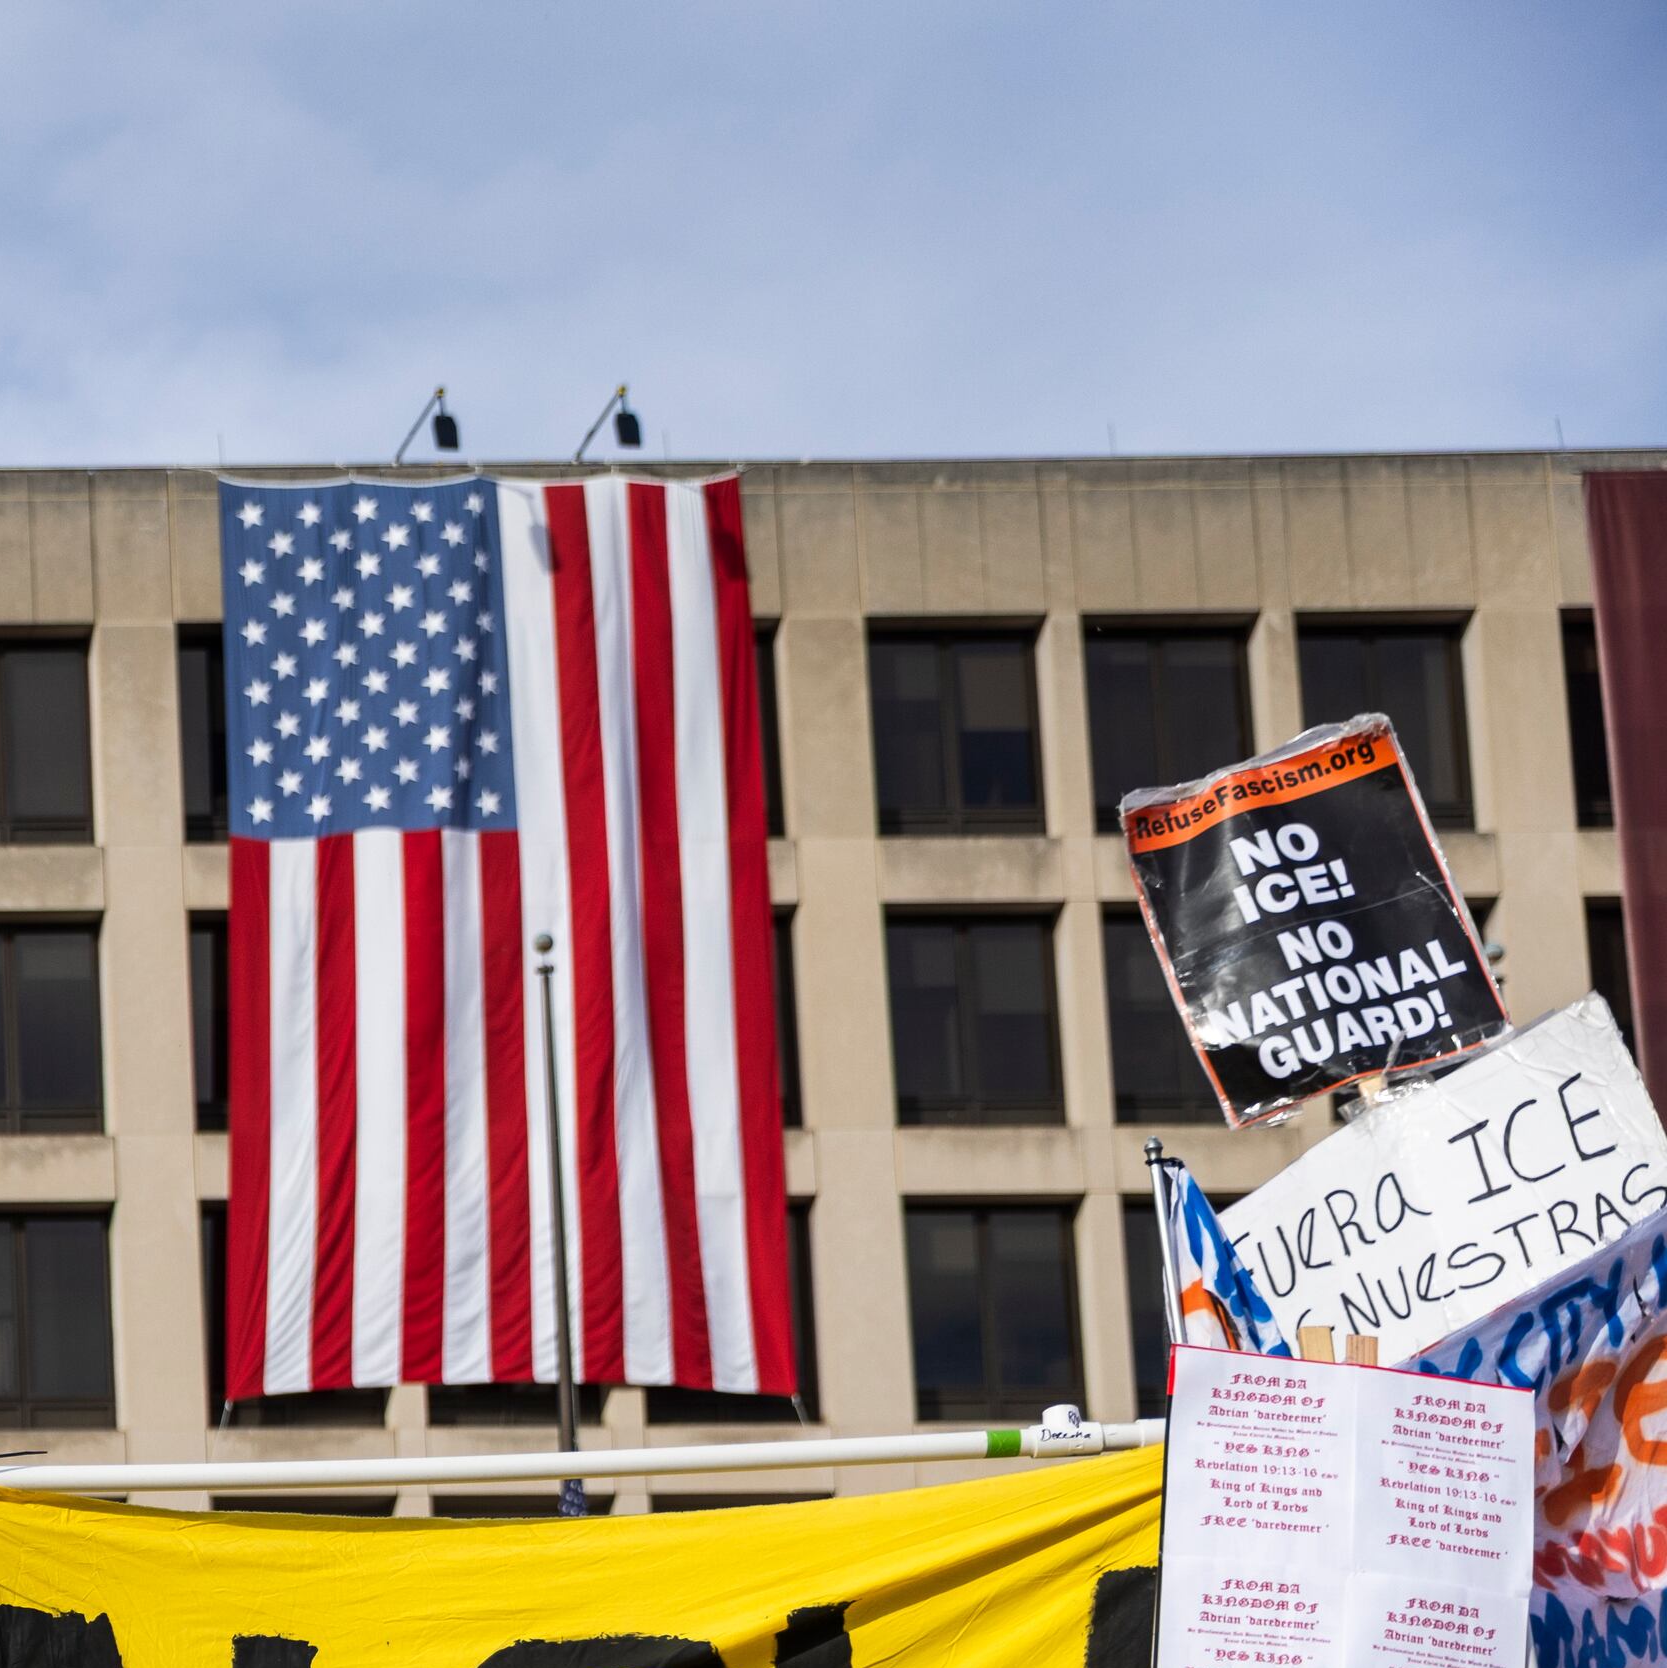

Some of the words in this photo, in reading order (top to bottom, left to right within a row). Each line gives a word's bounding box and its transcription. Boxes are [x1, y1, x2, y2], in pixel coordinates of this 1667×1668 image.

[1135, 740, 1376, 840] RefuseFascism.org
[1229, 823, 1319, 877] NO
[1234, 858, 1355, 925] ICE!
[1277, 920, 1353, 971] NO
[1206, 940, 1466, 1048] NATIONAL
[1258, 993, 1453, 1080] GUARD!
[1448, 1072, 1617, 1204] ICE
[1230, 1373, 1280, 1387] FROM
[1285, 1380, 1307, 1389] DA
[1211, 1388, 1296, 1406] KINGDOM
[1301, 1398, 1326, 1409] OF
[1412, 1395, 1460, 1410] FROM
[1465, 1402, 1486, 1413] DA
[1208, 1406, 1249, 1418] Adrian
[1394, 1408, 1476, 1429] KINGDOM
[1480, 1421, 1504, 1433] OF
[1392, 1424, 1431, 1439] Adrian
[1225, 1442, 1257, 1454] YES
[1262, 1445, 1309, 1458] KING
[1195, 1459, 1258, 1474] Revelation
[1408, 1462, 1440, 1475] YES
[1445, 1466, 1490, 1483] KING
[1210, 1479, 1240, 1492] King
[1245, 1482, 1255, 1491] of
[1260, 1483, 1297, 1496] Kings
[1302, 1488, 1322, 1497] and
[1380, 1477, 1441, 1495] Revelation
[1223, 1497, 1252, 1509] Lord
[1256, 1501, 1267, 1510] of
[1272, 1501, 1308, 1513] Lords
[1395, 1498, 1425, 1513] King
[1429, 1505, 1439, 1513] of
[1443, 1505, 1479, 1520] Kings
[1482, 1512, 1502, 1523] and
[1200, 1515, 1247, 1527] FREE
[1408, 1517, 1436, 1529] Lord
[1440, 1523, 1450, 1533] of
[1455, 1524, 1489, 1538] Lords
[1387, 1534, 1431, 1548] FREE
[1221, 1579, 1273, 1592] FROM
[1277, 1584, 1301, 1594] DA
[1201, 1594, 1289, 1611] KINGDOM
[1294, 1602, 1319, 1614] OF
[1406, 1598, 1454, 1614] FROM
[1458, 1606, 1480, 1618] DA
[1199, 1612, 1241, 1624] Adrian
[1387, 1612, 1469, 1633] KINGDOM
[1473, 1627, 1496, 1640] OF
[1384, 1629, 1424, 1644] Adrian
[1215, 1649, 1250, 1661] YES
[1254, 1652, 1303, 1664] KING
